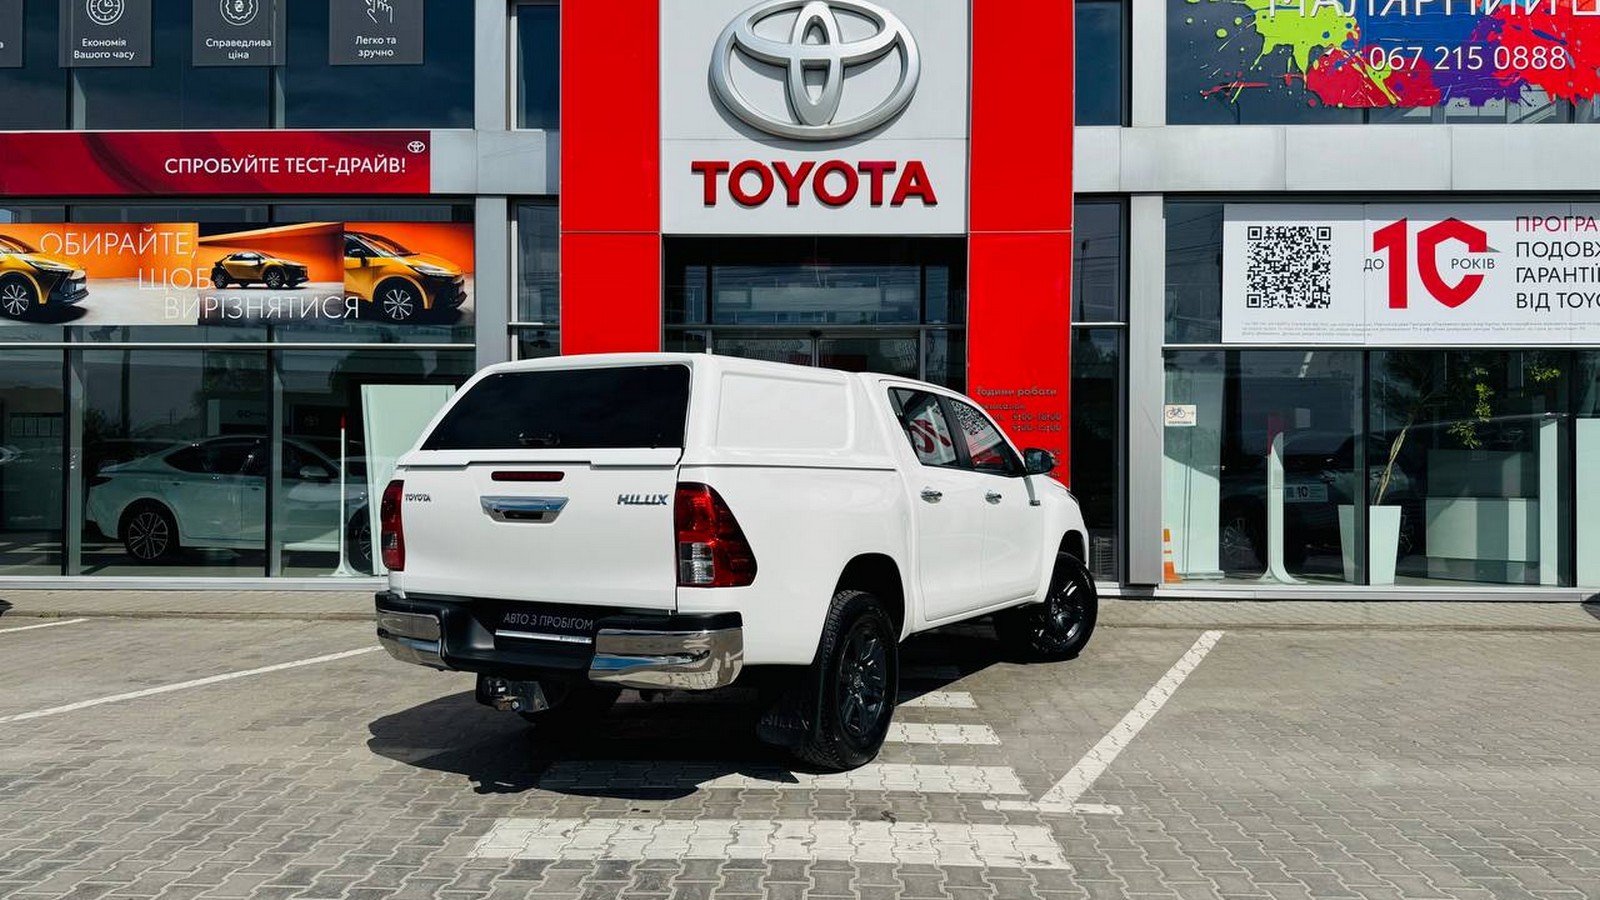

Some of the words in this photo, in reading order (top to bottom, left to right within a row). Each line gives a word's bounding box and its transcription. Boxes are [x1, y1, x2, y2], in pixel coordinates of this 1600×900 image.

[82, 38, 127, 47] Економія
[205, 38, 272, 48] Справедлива
[355, 36, 384, 46] Легко
[386, 37, 397, 45] та
[74, 50, 111, 59] Вашого
[112, 51, 135, 61] часу
[228, 50, 250, 60] ціна
[358, 48, 394, 58] зручно
[1369, 46, 1423, 71] 067
[1434, 46, 1483, 71] 215
[1494, 46, 1566, 71] 0888
[164, 154, 280, 174] СПРОБУЙТЕ
[284, 154, 406, 176] ТЕСТ-ДРАЙВ!
[691, 160, 938, 206] TOYOTA
[39, 228, 198, 259] ОБИРАЙТЕ,
[1364, 258, 1385, 272] ДО
[1451, 258, 1496, 270] РОКІВ
[138, 267, 212, 292] ЩОБ
[164, 296, 360, 320] ВИРІЗНЯТИСЯ
[1516, 292, 1550, 312] ВІД
[1556, 292, 1600, 308] TOY
[405, 493, 432, 502] TOYOTA
[617, 494, 669, 505] HILUX
[503, 612, 529, 625] АВТО
[539, 615, 594, 630] ПРОБІГОМ
